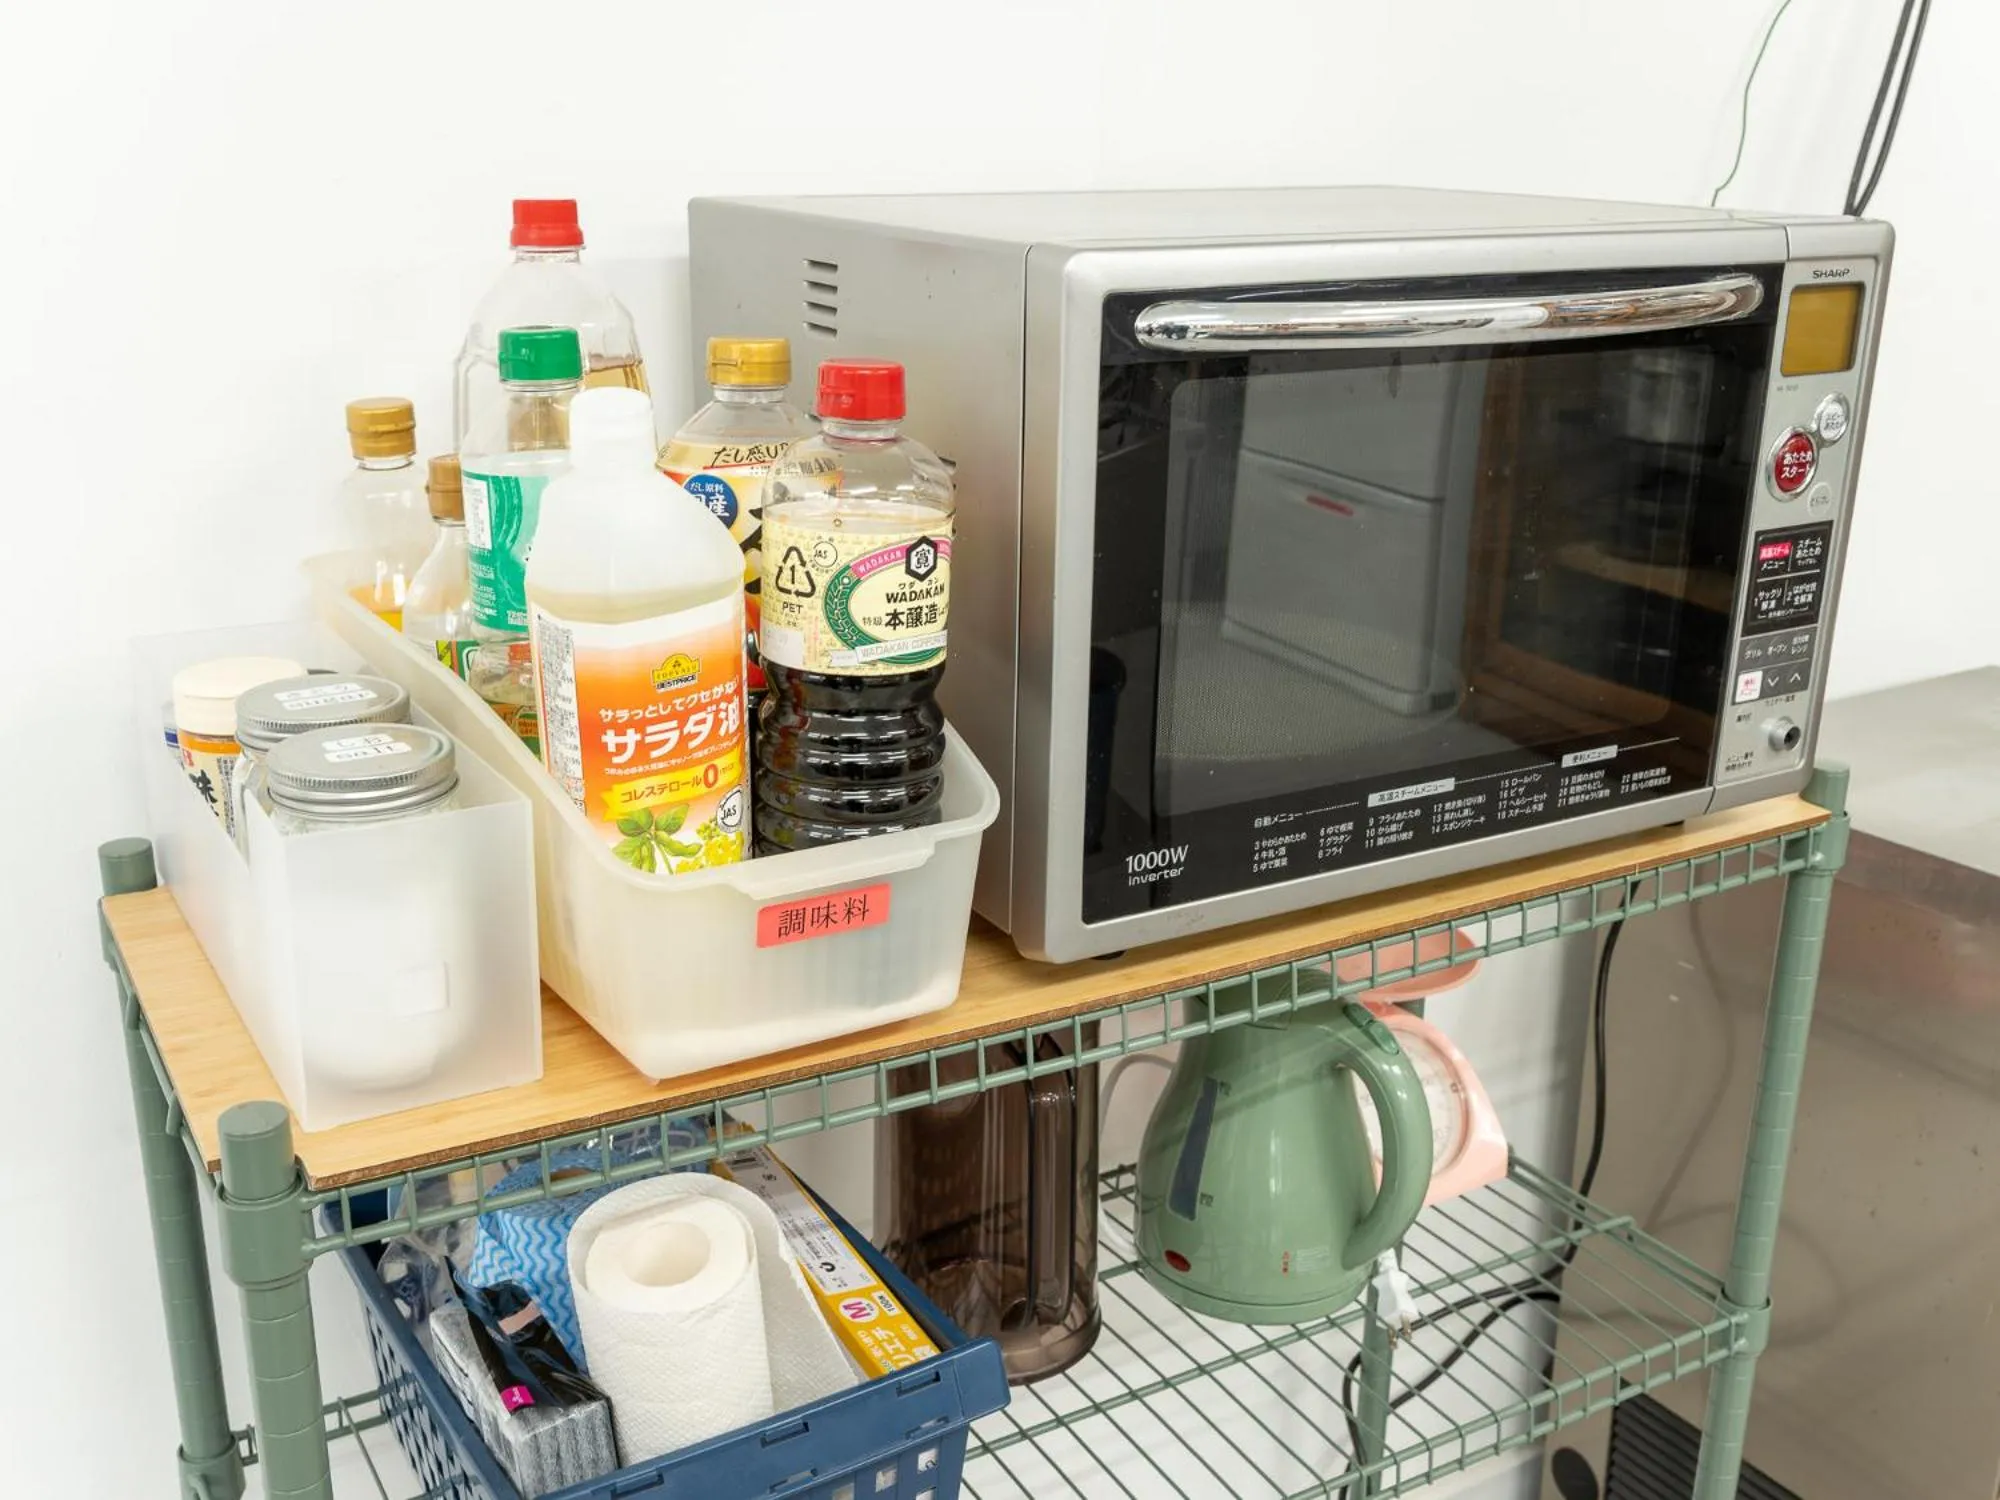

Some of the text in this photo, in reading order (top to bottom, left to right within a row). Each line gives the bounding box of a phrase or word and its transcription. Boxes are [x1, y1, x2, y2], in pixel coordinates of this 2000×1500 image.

[1812, 268, 1850, 279] SHARP
[1783, 451, 1813, 465] あたため
[1781, 464, 1811, 479] スタート
[690, 482, 724, 494] だし原料
[813, 549, 828, 559] JAS
[858, 550, 902, 573] WADAKAN
[885, 583, 945, 604] WADAKAN
[782, 601, 803, 614] PET
[861, 640, 909, 657] WADAKAN
[601, 695, 740, 764] サラダ油
[1500, 773, 1542, 789] 15 ロールパン
[621, 775, 702, 803] コレステロール
[1499, 785, 1526, 799] 16 ピザ
[1433, 802, 1443, 813] 12
[1498, 791, 1548, 810] 17 ヘルシーセット
[720, 804, 737, 820] JAS
[1368, 807, 1421, 828] 9 フライあたため
[1432, 813, 1442, 824] 13
[1498, 809, 1506, 820] 18
[1254, 812, 1303, 828] 自動メニュー
[1431, 815, 1486, 835] 14 スポンジケーキ
[1366, 827, 1376, 838] 10
[1254, 839, 1260, 851] 3
[1319, 834, 1352, 848] 7 グラタン
[1364, 839, 1374, 849] 11
[1254, 851, 1260, 861] 4
[1325, 844, 1344, 857] フライ
[1125, 844, 1189, 874] 1000W
[1252, 863, 1258, 873] 5
[778, 894, 869, 938] 調味料
[842, 1300, 871, 1320] M
